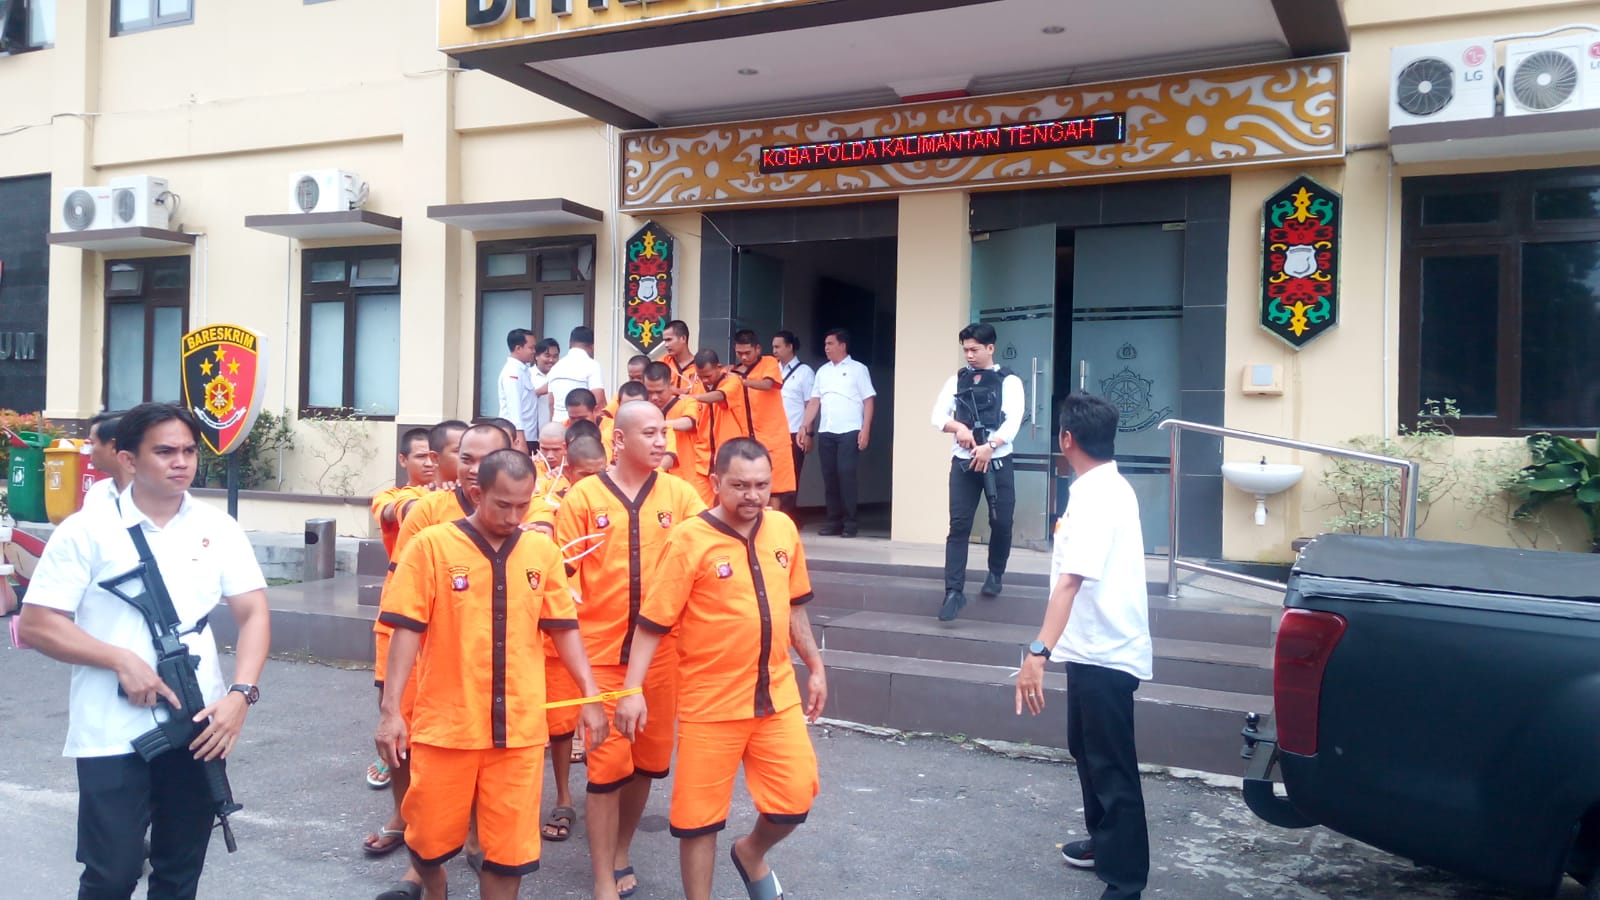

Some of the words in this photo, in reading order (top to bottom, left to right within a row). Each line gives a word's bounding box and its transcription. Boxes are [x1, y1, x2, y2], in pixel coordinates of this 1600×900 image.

[1464, 70, 1484, 82] LG
[763, 146, 811, 168] KOBA
[815, 140, 877, 163] POLDA
[880, 129, 1000, 158] KALIMANTAN
[1004, 118, 1095, 146] TENGAH
[187, 326, 254, 350] BARESKRIM
